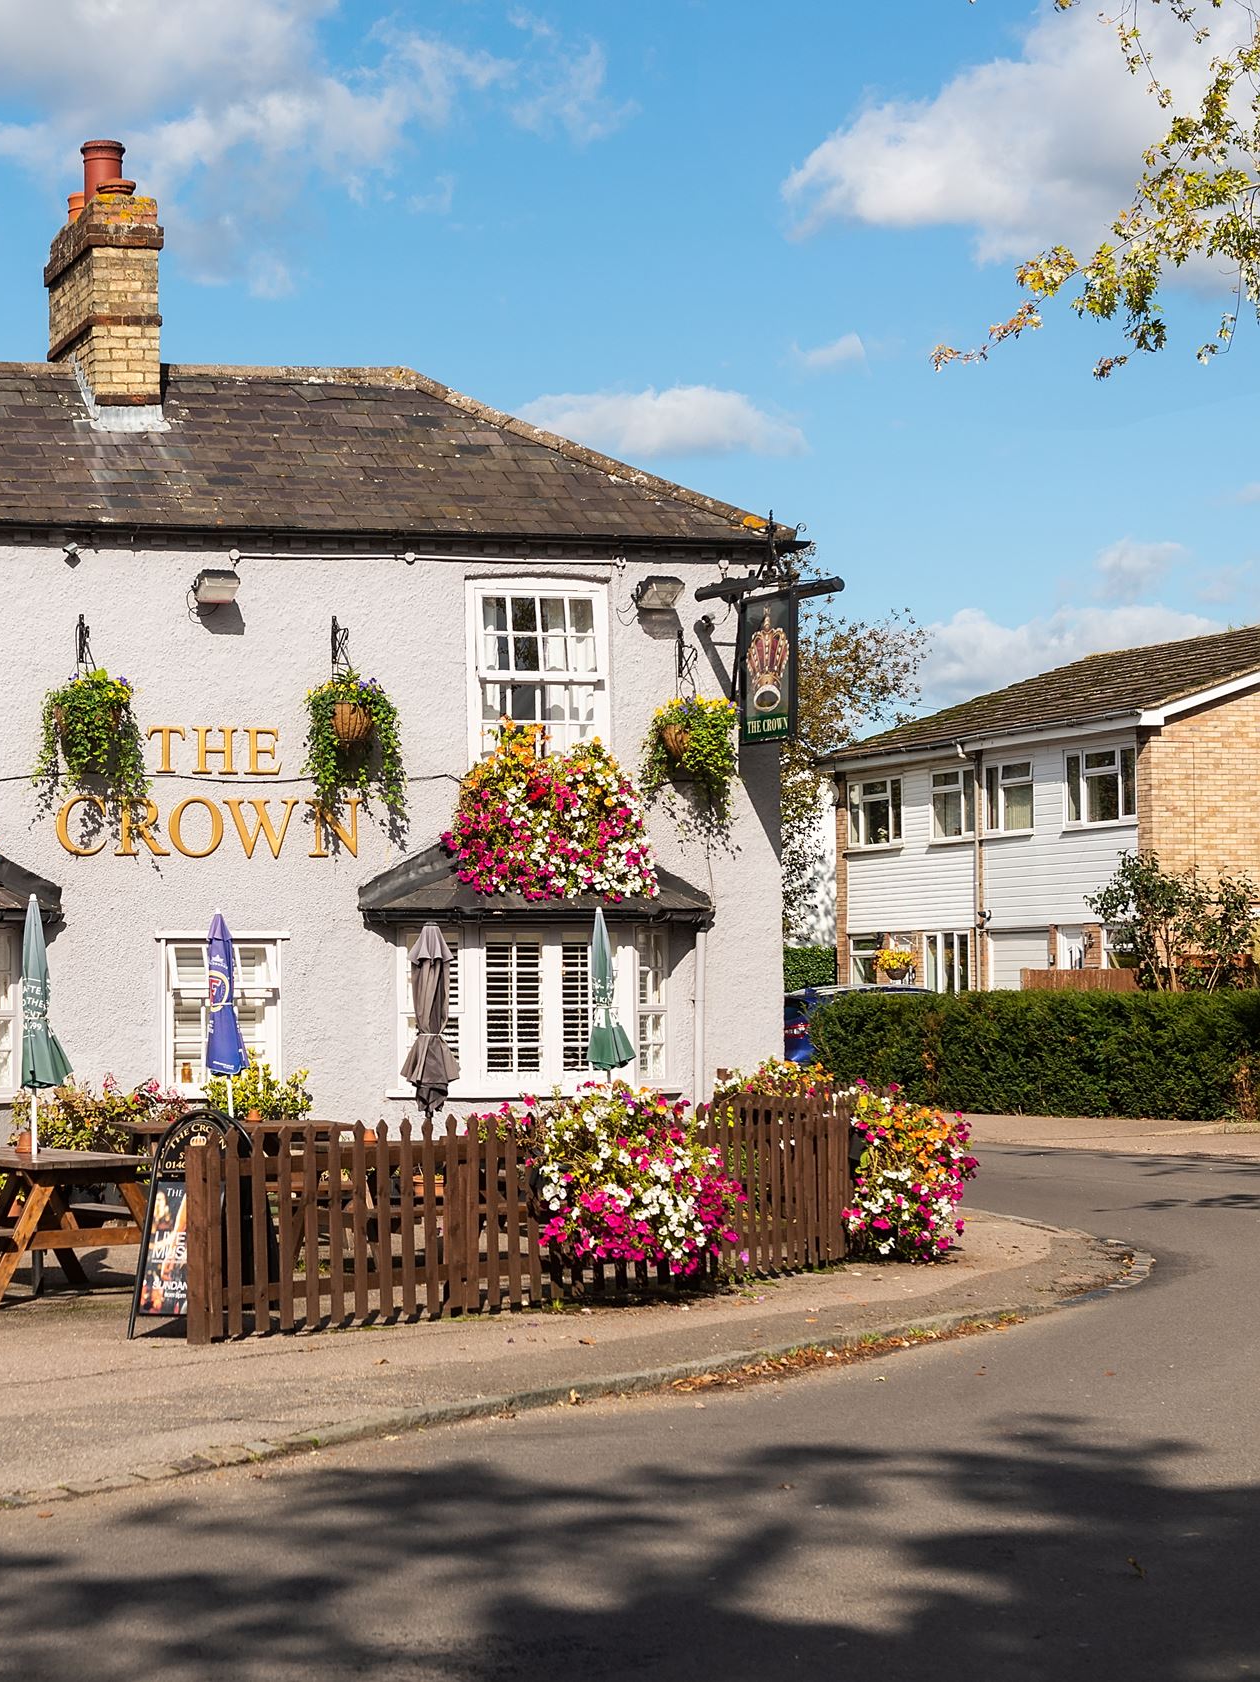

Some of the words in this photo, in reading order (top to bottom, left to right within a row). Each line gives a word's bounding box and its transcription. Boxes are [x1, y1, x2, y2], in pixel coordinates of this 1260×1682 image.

[747, 720, 762, 734] THE
[762, 716, 789, 732] CROWN
[147, 725, 283, 776] THE
[55, 794, 363, 860] CROWN
[170, 1128, 190, 1149] THE
[191, 1123, 227, 1150] CRON
[154, 1231, 187, 1245] LIVE
[151, 1245, 186, 1260] MUS
